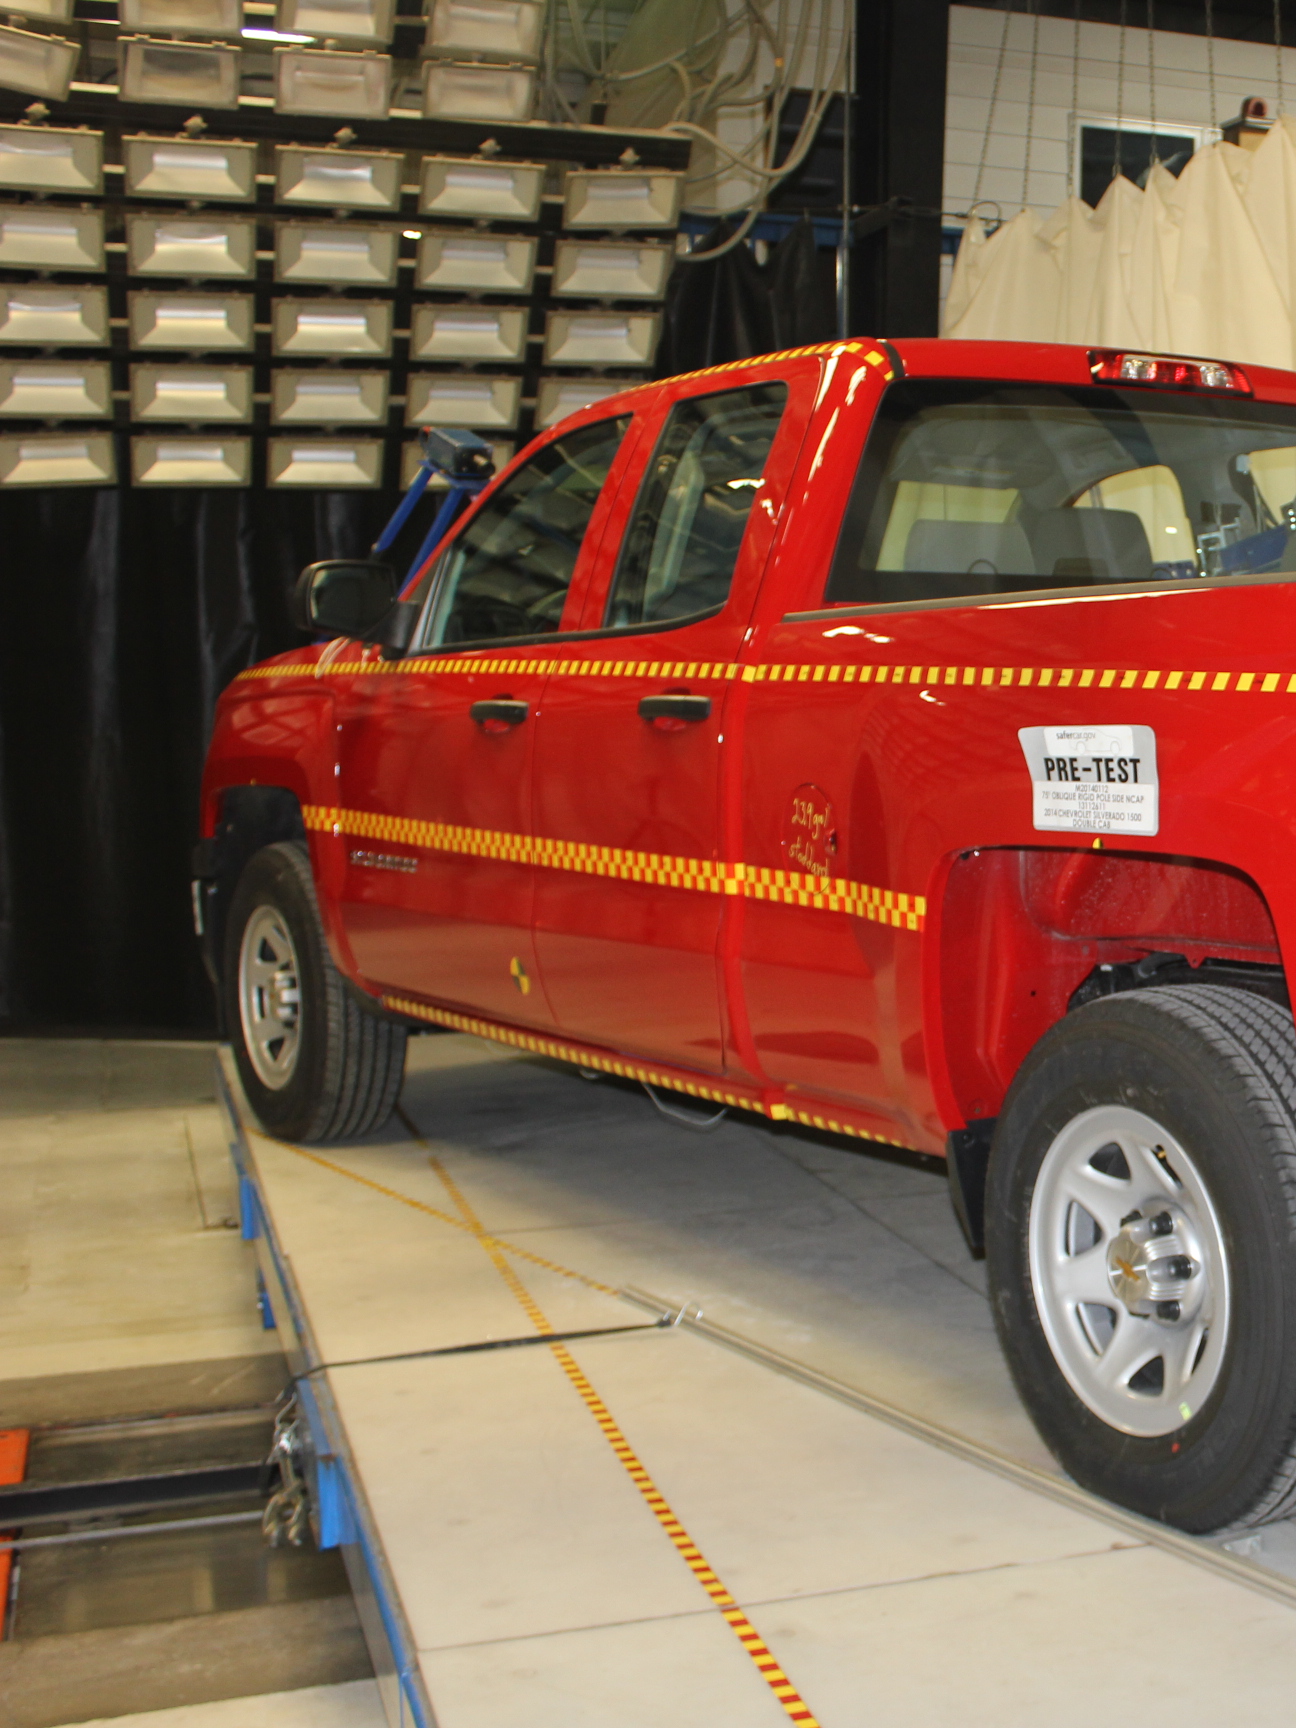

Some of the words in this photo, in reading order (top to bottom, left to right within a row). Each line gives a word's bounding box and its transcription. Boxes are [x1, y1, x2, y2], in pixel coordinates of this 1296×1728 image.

[1056, 731, 1096, 741] safercar.gov
[1044, 757, 1141, 783] PRE-TEST
[1075, 784, 1109, 793] M20140112
[1051, 791, 1076, 801] OBLIQUE
[1078, 792, 1095, 802] RIGID
[1096, 793, 1111, 803] POLE
[1112, 794, 1124, 803] SIDE
[1126, 795, 1144, 804] NCAP
[1078, 802, 1106, 811] 13112611
[1044, 808, 1058, 817] 2014
[1058, 809, 1092, 819] CHEVROLET
[1093, 811, 1125, 821] SILVERADO
[1127, 813, 1142, 822] 1500
[1072, 819, 1096, 828] DOUBLE
[1097, 820, 1111, 829] CAB
